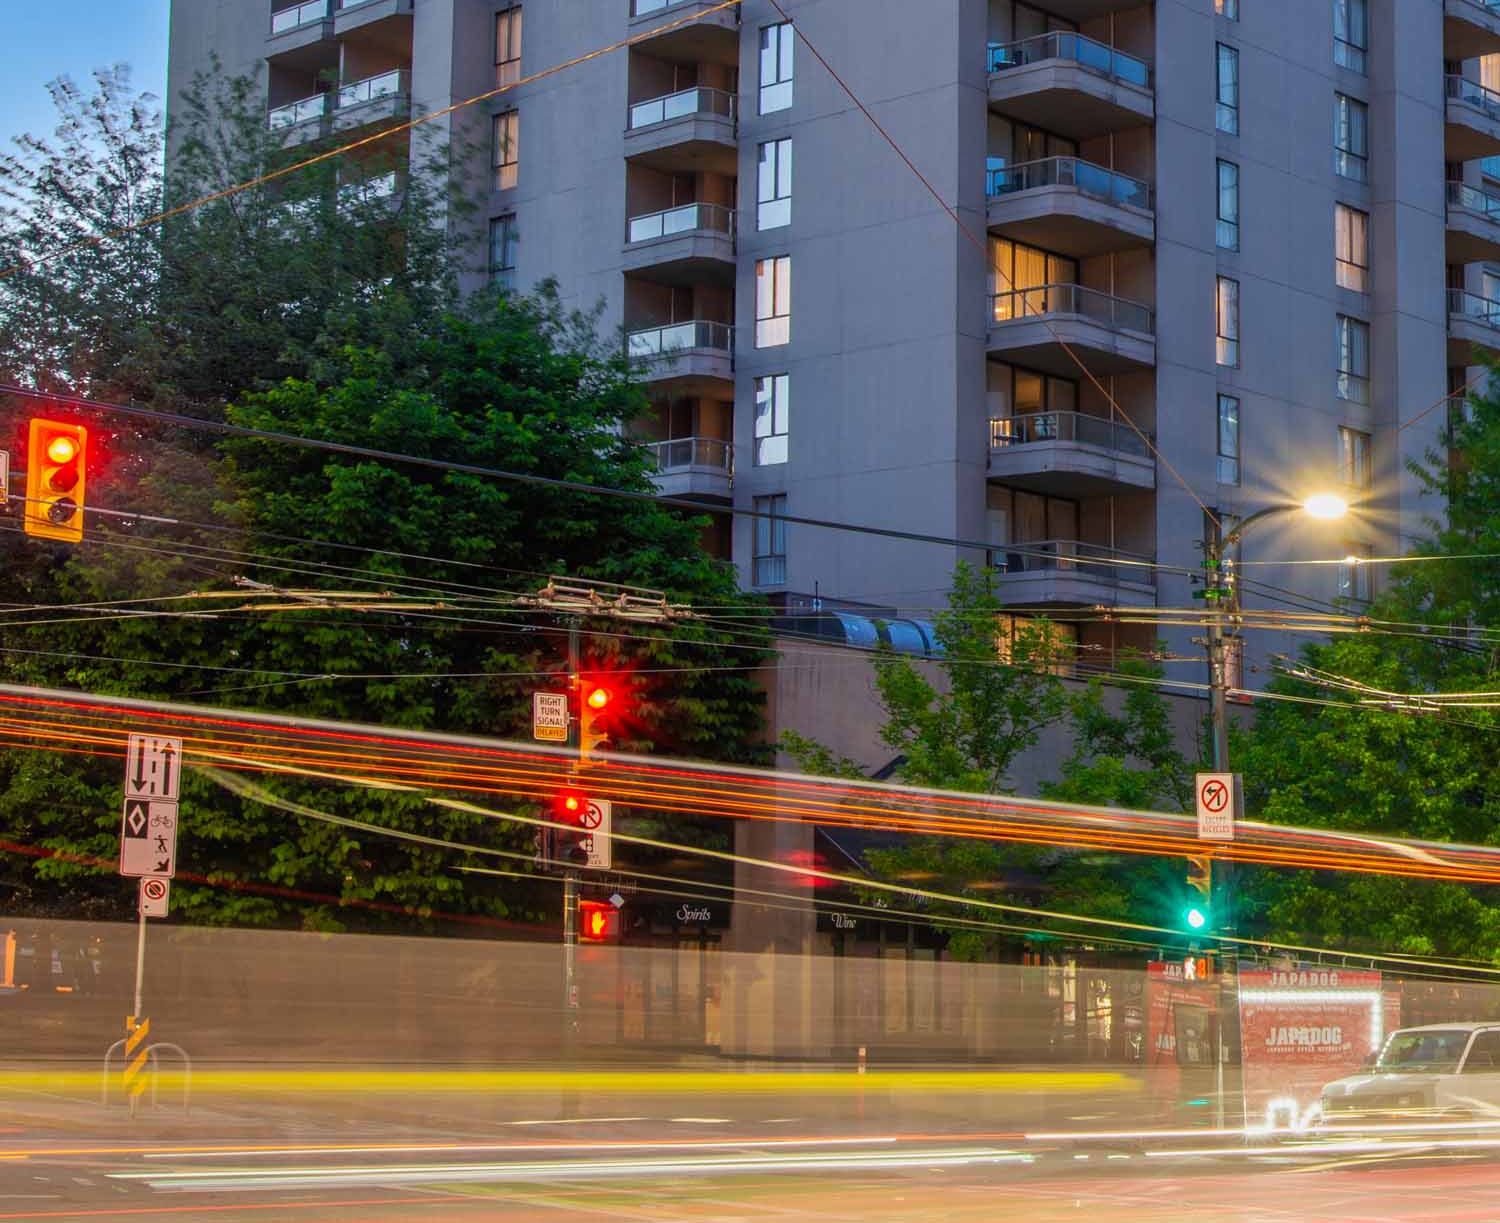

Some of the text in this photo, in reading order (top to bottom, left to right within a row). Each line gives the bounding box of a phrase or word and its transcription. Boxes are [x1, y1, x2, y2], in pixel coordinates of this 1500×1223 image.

[539, 696, 561, 706] RIGHT
[540, 707, 560, 716] TURN
[537, 716, 564, 726] SIGNAL
[676, 904, 711, 923] Spirits
[831, 912, 857, 928] Wine
[1269, 972, 1339, 986] JAPADOG
[1265, 1026, 1342, 1046] JAPADOG
